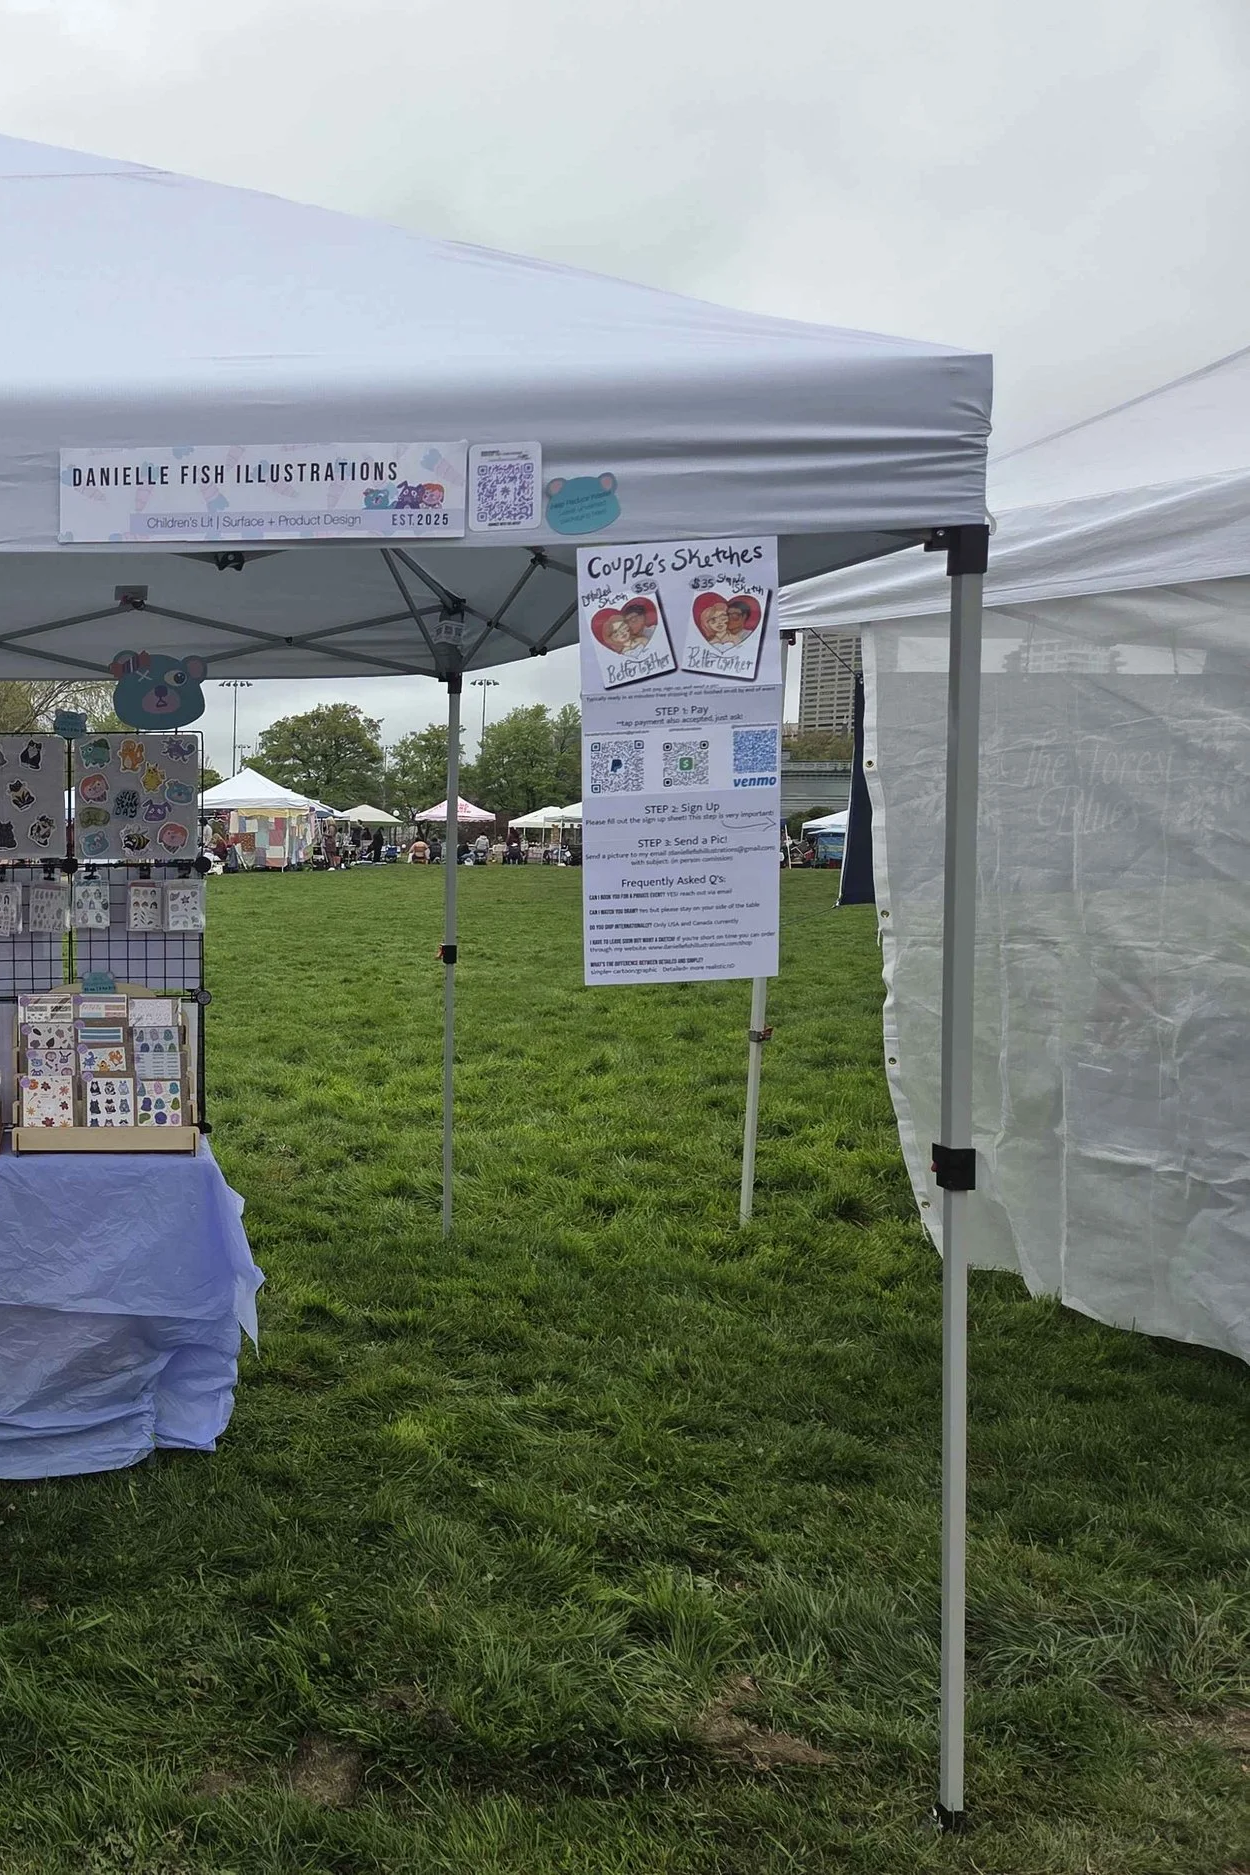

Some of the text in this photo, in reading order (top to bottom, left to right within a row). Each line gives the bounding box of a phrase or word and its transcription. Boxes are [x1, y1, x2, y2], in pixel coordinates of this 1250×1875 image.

[73, 462, 398, 487] DANIELLE FISH ILLUSTRATIONS
[146, 516, 198, 530] Children's
[200, 516, 213, 528] Lit
[222, 515, 264, 528] Surface
[278, 514, 321, 527] Product
[324, 514, 361, 528] Design
[587, 545, 763, 585] Couple's Sketches
[634, 582, 657, 594] $50
[691, 577, 715, 590] $35
[687, 646, 717, 669] Better
[607, 660, 638, 683] Better
[654, 707, 679, 716] STEP
[691, 705, 709, 717] Pay
[635, 718, 664, 727] payment
[733, 776, 777, 788] venmo
[645, 805, 669, 815] STEP
[681, 803, 703, 815] Sign
[706, 802, 720, 813] Up
[629, 816, 641, 824] the
[638, 839, 662, 848] STEP
[674, 836, 699, 846] Send
[710, 834, 728, 844] Pic!
[607, 852, 629, 860] picture
[622, 875, 674, 890] Frequently
[676, 875, 706, 885] Asked
